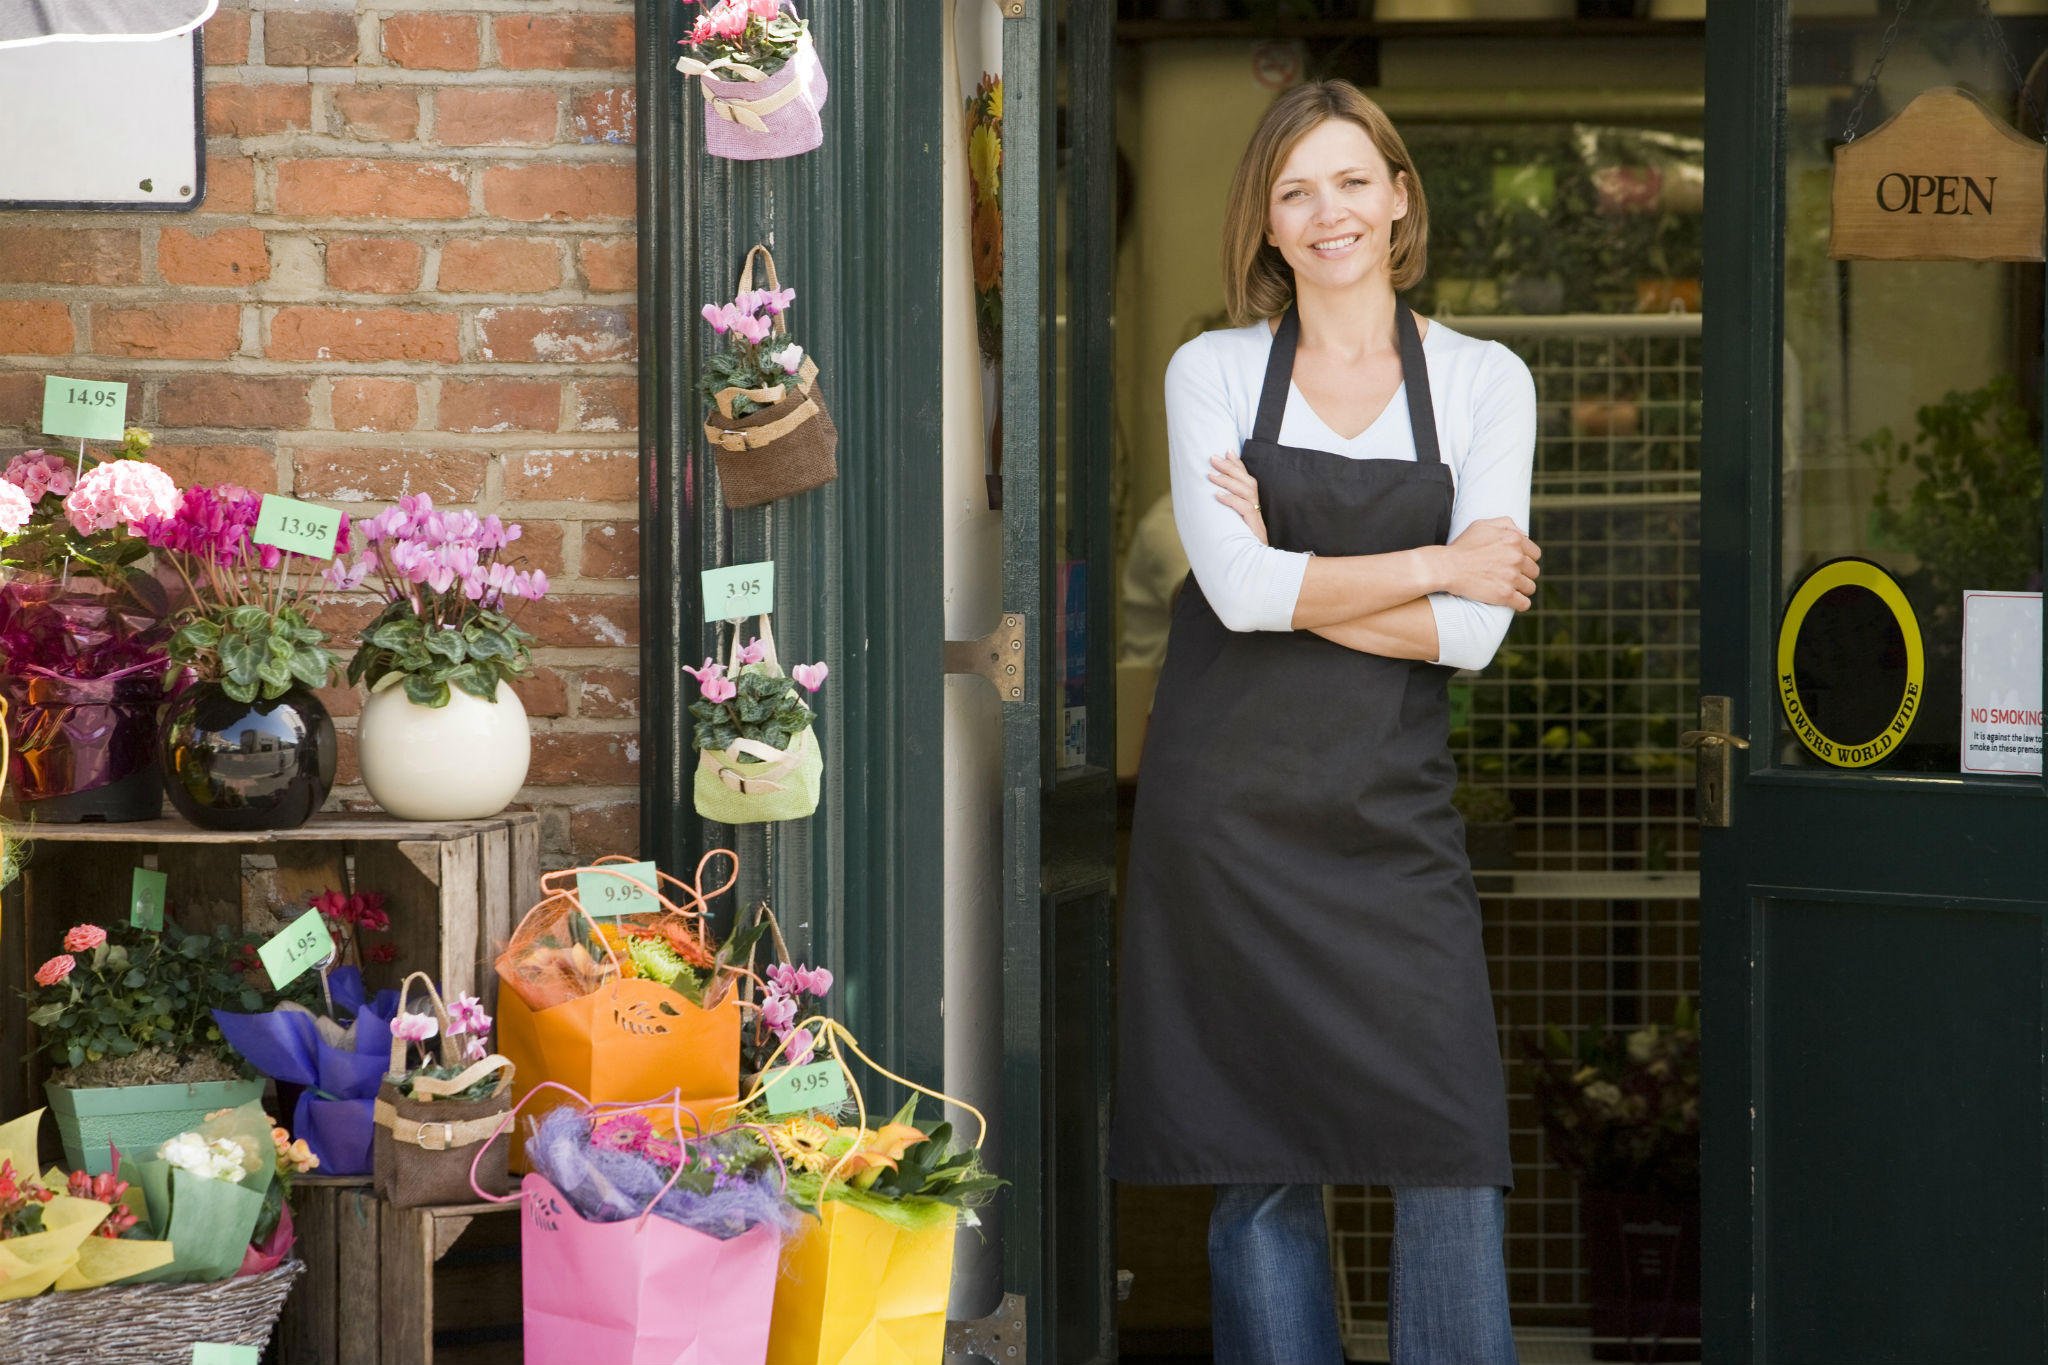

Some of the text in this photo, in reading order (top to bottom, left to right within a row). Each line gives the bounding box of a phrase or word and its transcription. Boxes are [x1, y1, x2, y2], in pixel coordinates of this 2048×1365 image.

[1876, 172, 1998, 215] OPEN
[66, 388, 117, 408] 14.95
[279, 516, 328, 540] 13.95
[726, 579, 760, 599] 395
[1782, 673, 1919, 763] FLOWERS WORLD WIDE
[1971, 708, 1988, 723] NO
[1974, 731, 2042, 743] It is against the law to
[1969, 743, 1990, 752] smoke
[1991, 743, 1998, 752] in
[1999, 744, 2017, 753] these
[605, 885, 643, 902] 9.95
[286, 931, 317, 962] 1.95
[791, 1071, 829, 1093] 9.95
